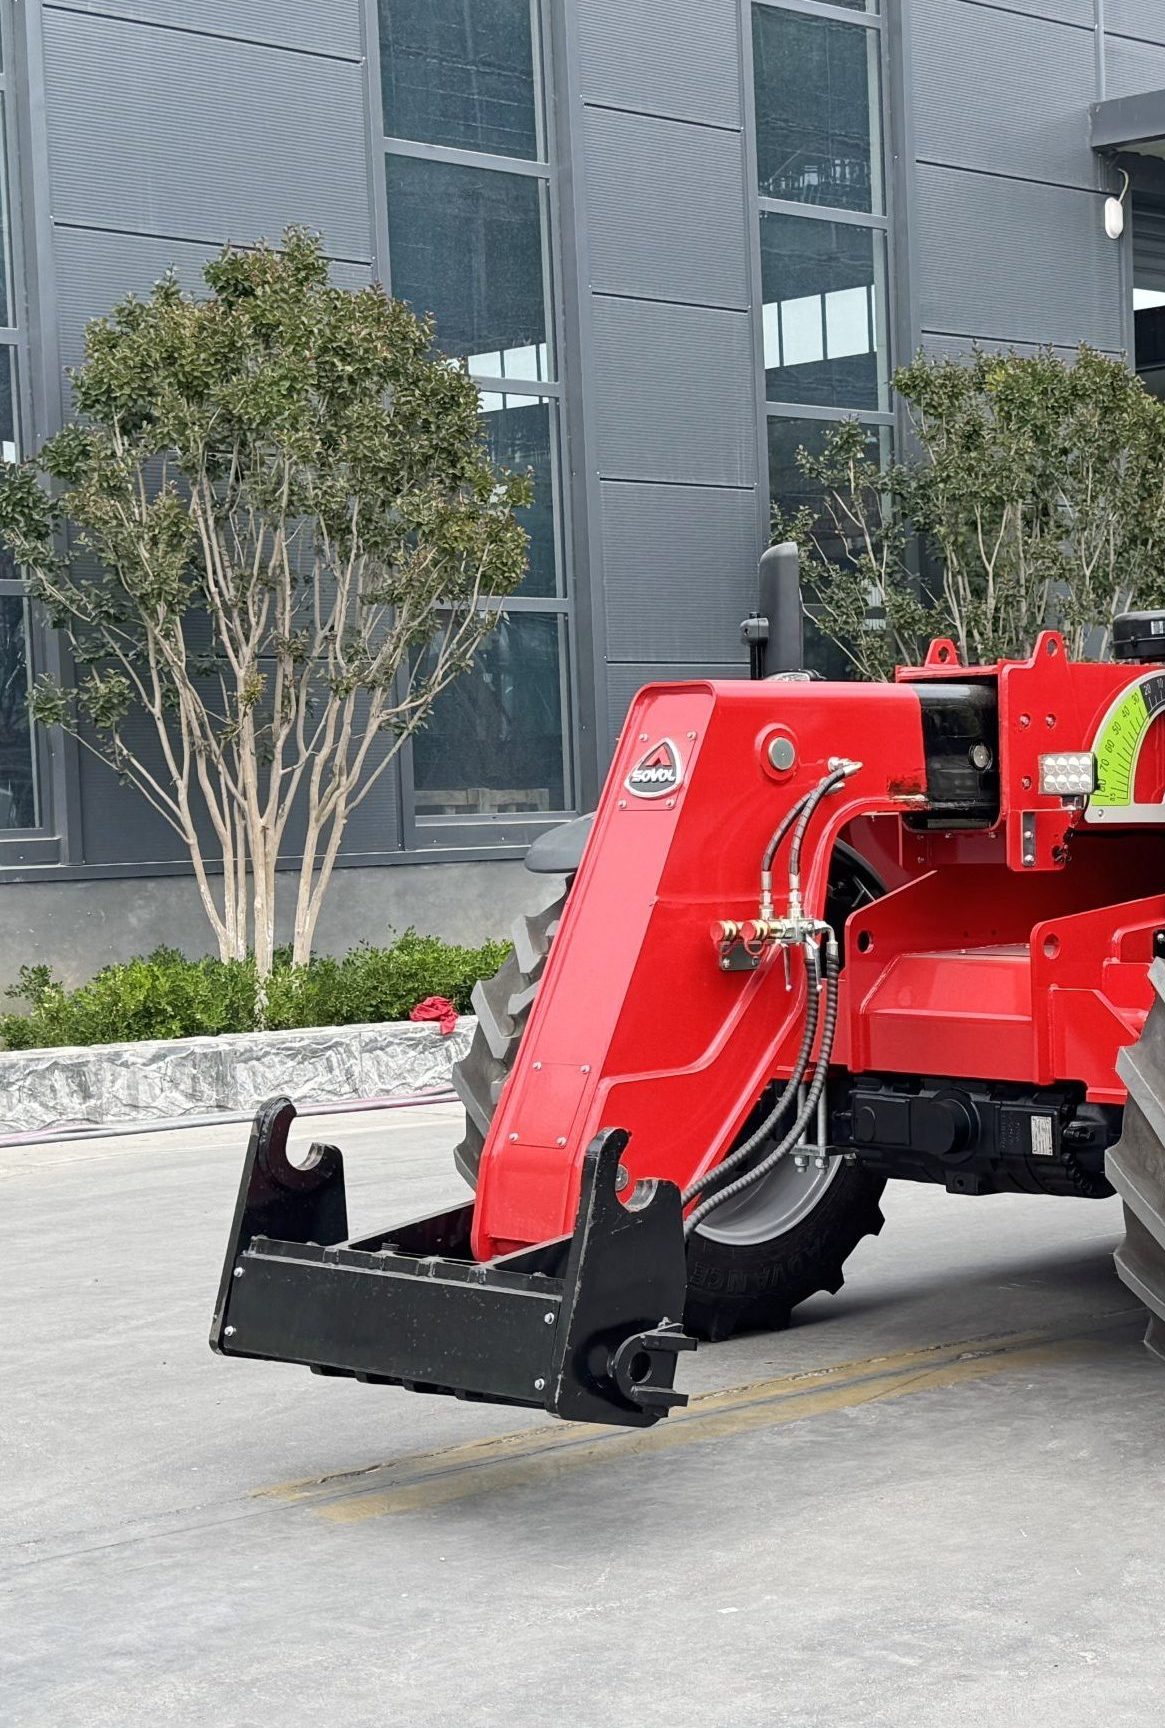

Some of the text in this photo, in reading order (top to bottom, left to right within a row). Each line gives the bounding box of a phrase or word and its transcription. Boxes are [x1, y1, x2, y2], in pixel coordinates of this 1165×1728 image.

[1144, 683, 1152, 695] 20
[1157, 678, 1164, 688] 10
[1131, 692, 1140, 705] 30
[1121, 705, 1130, 718] 40
[1112, 721, 1121, 735] 50
[1104, 739, 1115, 754] 60
[1100, 758, 1110, 772] 70
[631, 768, 676, 783] SOVOL
